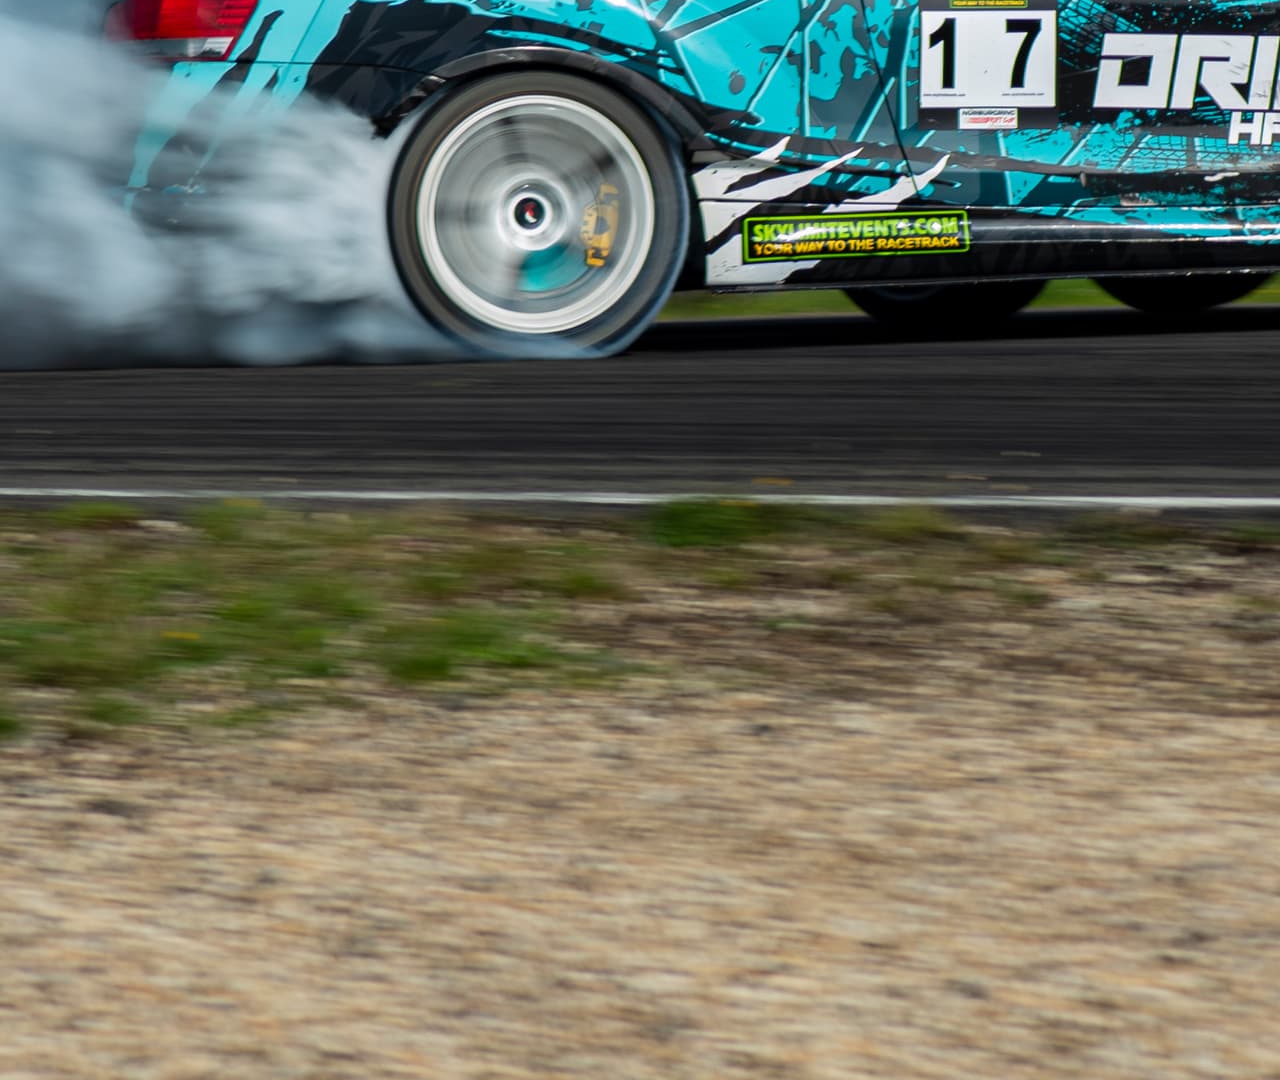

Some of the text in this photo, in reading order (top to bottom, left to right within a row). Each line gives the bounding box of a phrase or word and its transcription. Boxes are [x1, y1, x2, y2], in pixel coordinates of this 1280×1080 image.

[752, 217, 959, 242] SKYLIMITEVENTS.COM
[753, 236, 960, 256] YOUR WAY TO THE RACETRACK
